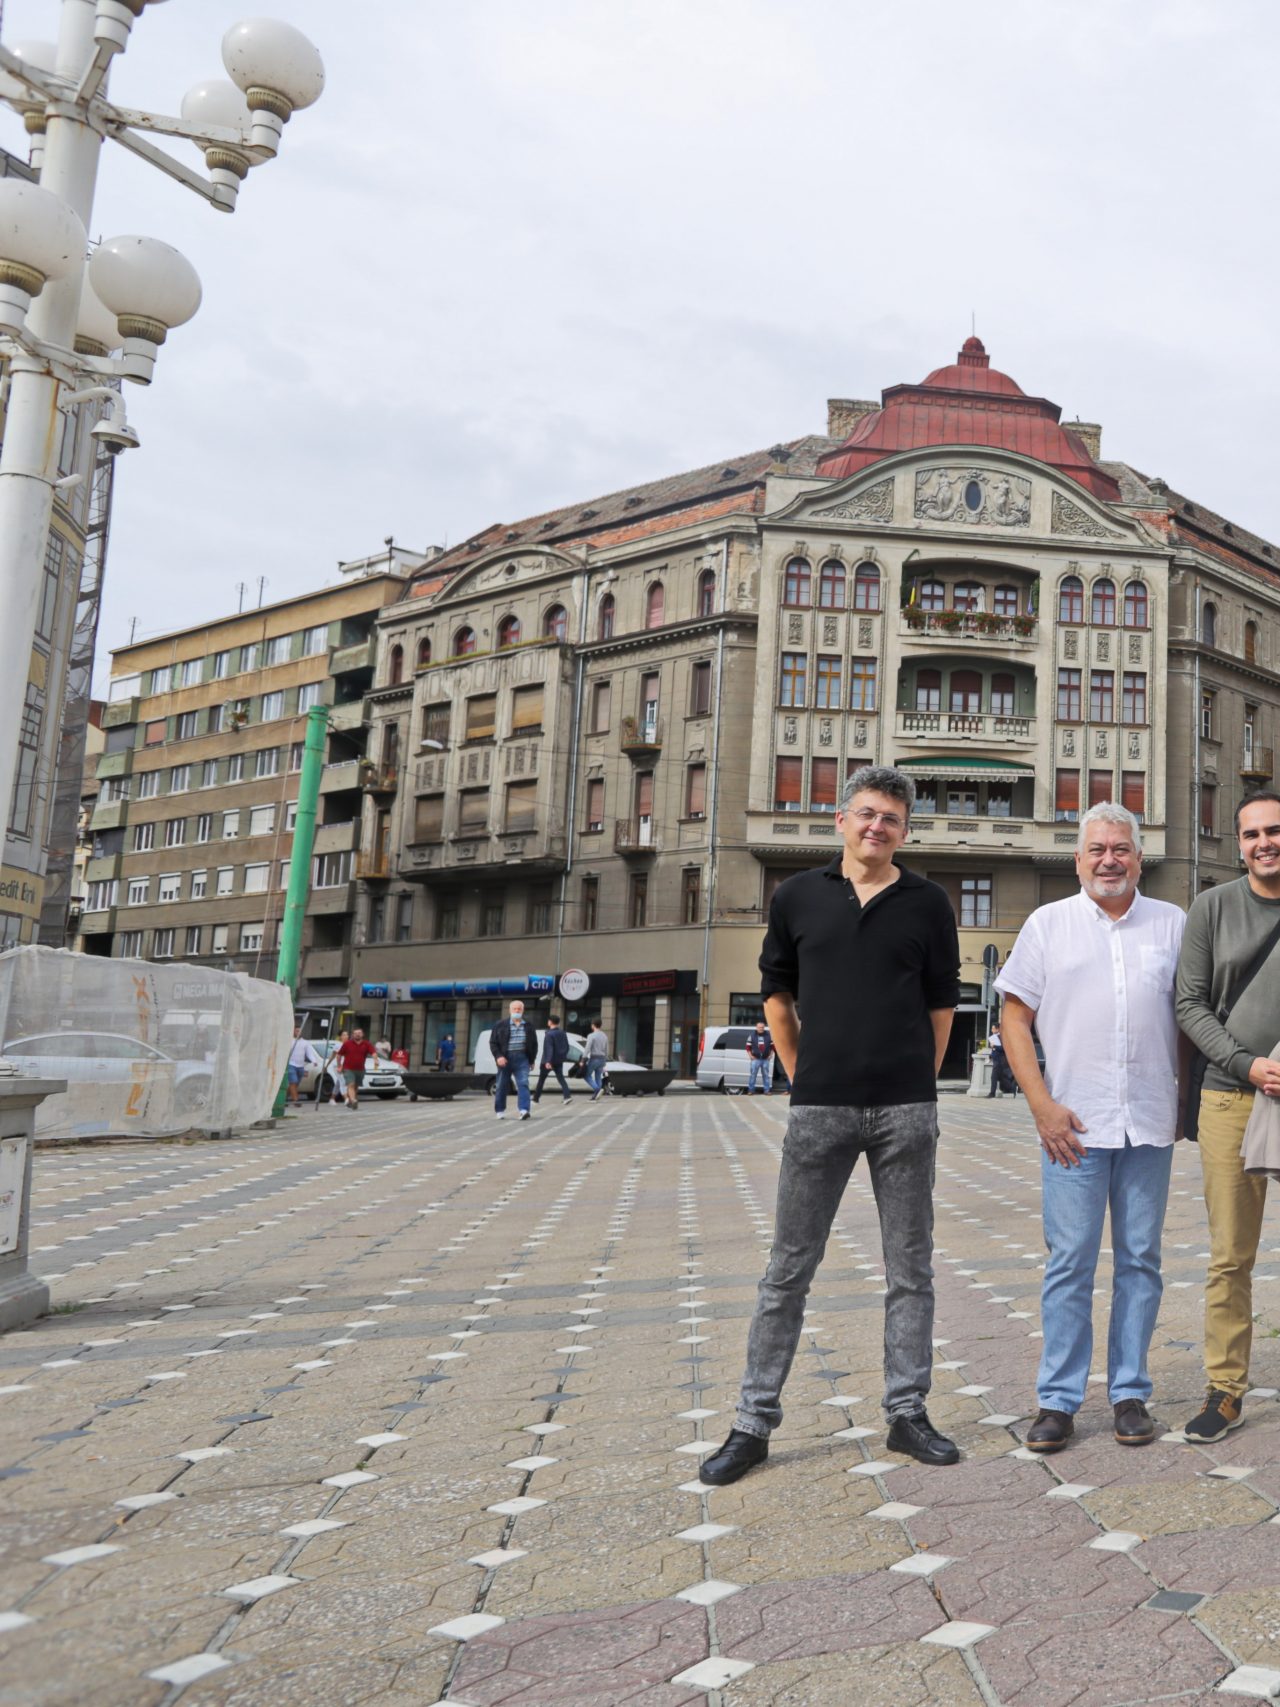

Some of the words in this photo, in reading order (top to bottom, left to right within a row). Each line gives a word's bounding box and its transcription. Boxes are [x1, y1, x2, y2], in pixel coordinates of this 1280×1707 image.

[0, 880, 19, 900] edit
[531, 978, 549, 990] citi
[367, 986, 383, 997] citi
